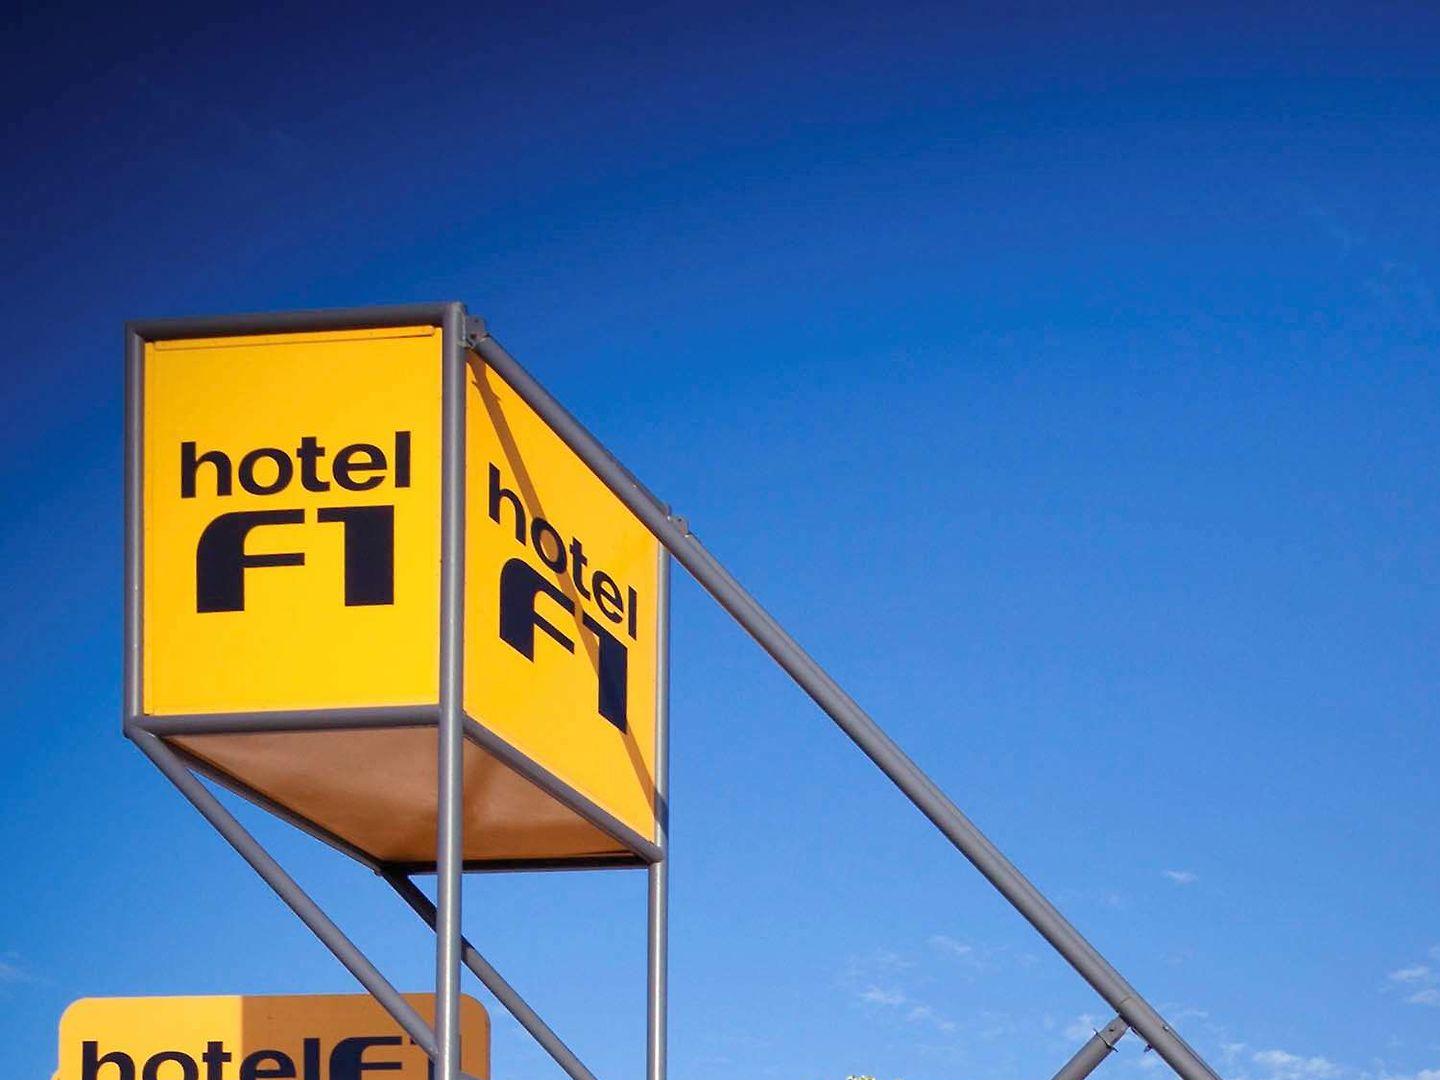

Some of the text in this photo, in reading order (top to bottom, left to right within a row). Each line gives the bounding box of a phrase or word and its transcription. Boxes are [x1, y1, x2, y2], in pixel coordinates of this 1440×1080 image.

[181, 431, 411, 499] hotel
[196, 505, 395, 614] F1
[489, 462, 638, 641] hotel
[499, 557, 629, 733] F1
